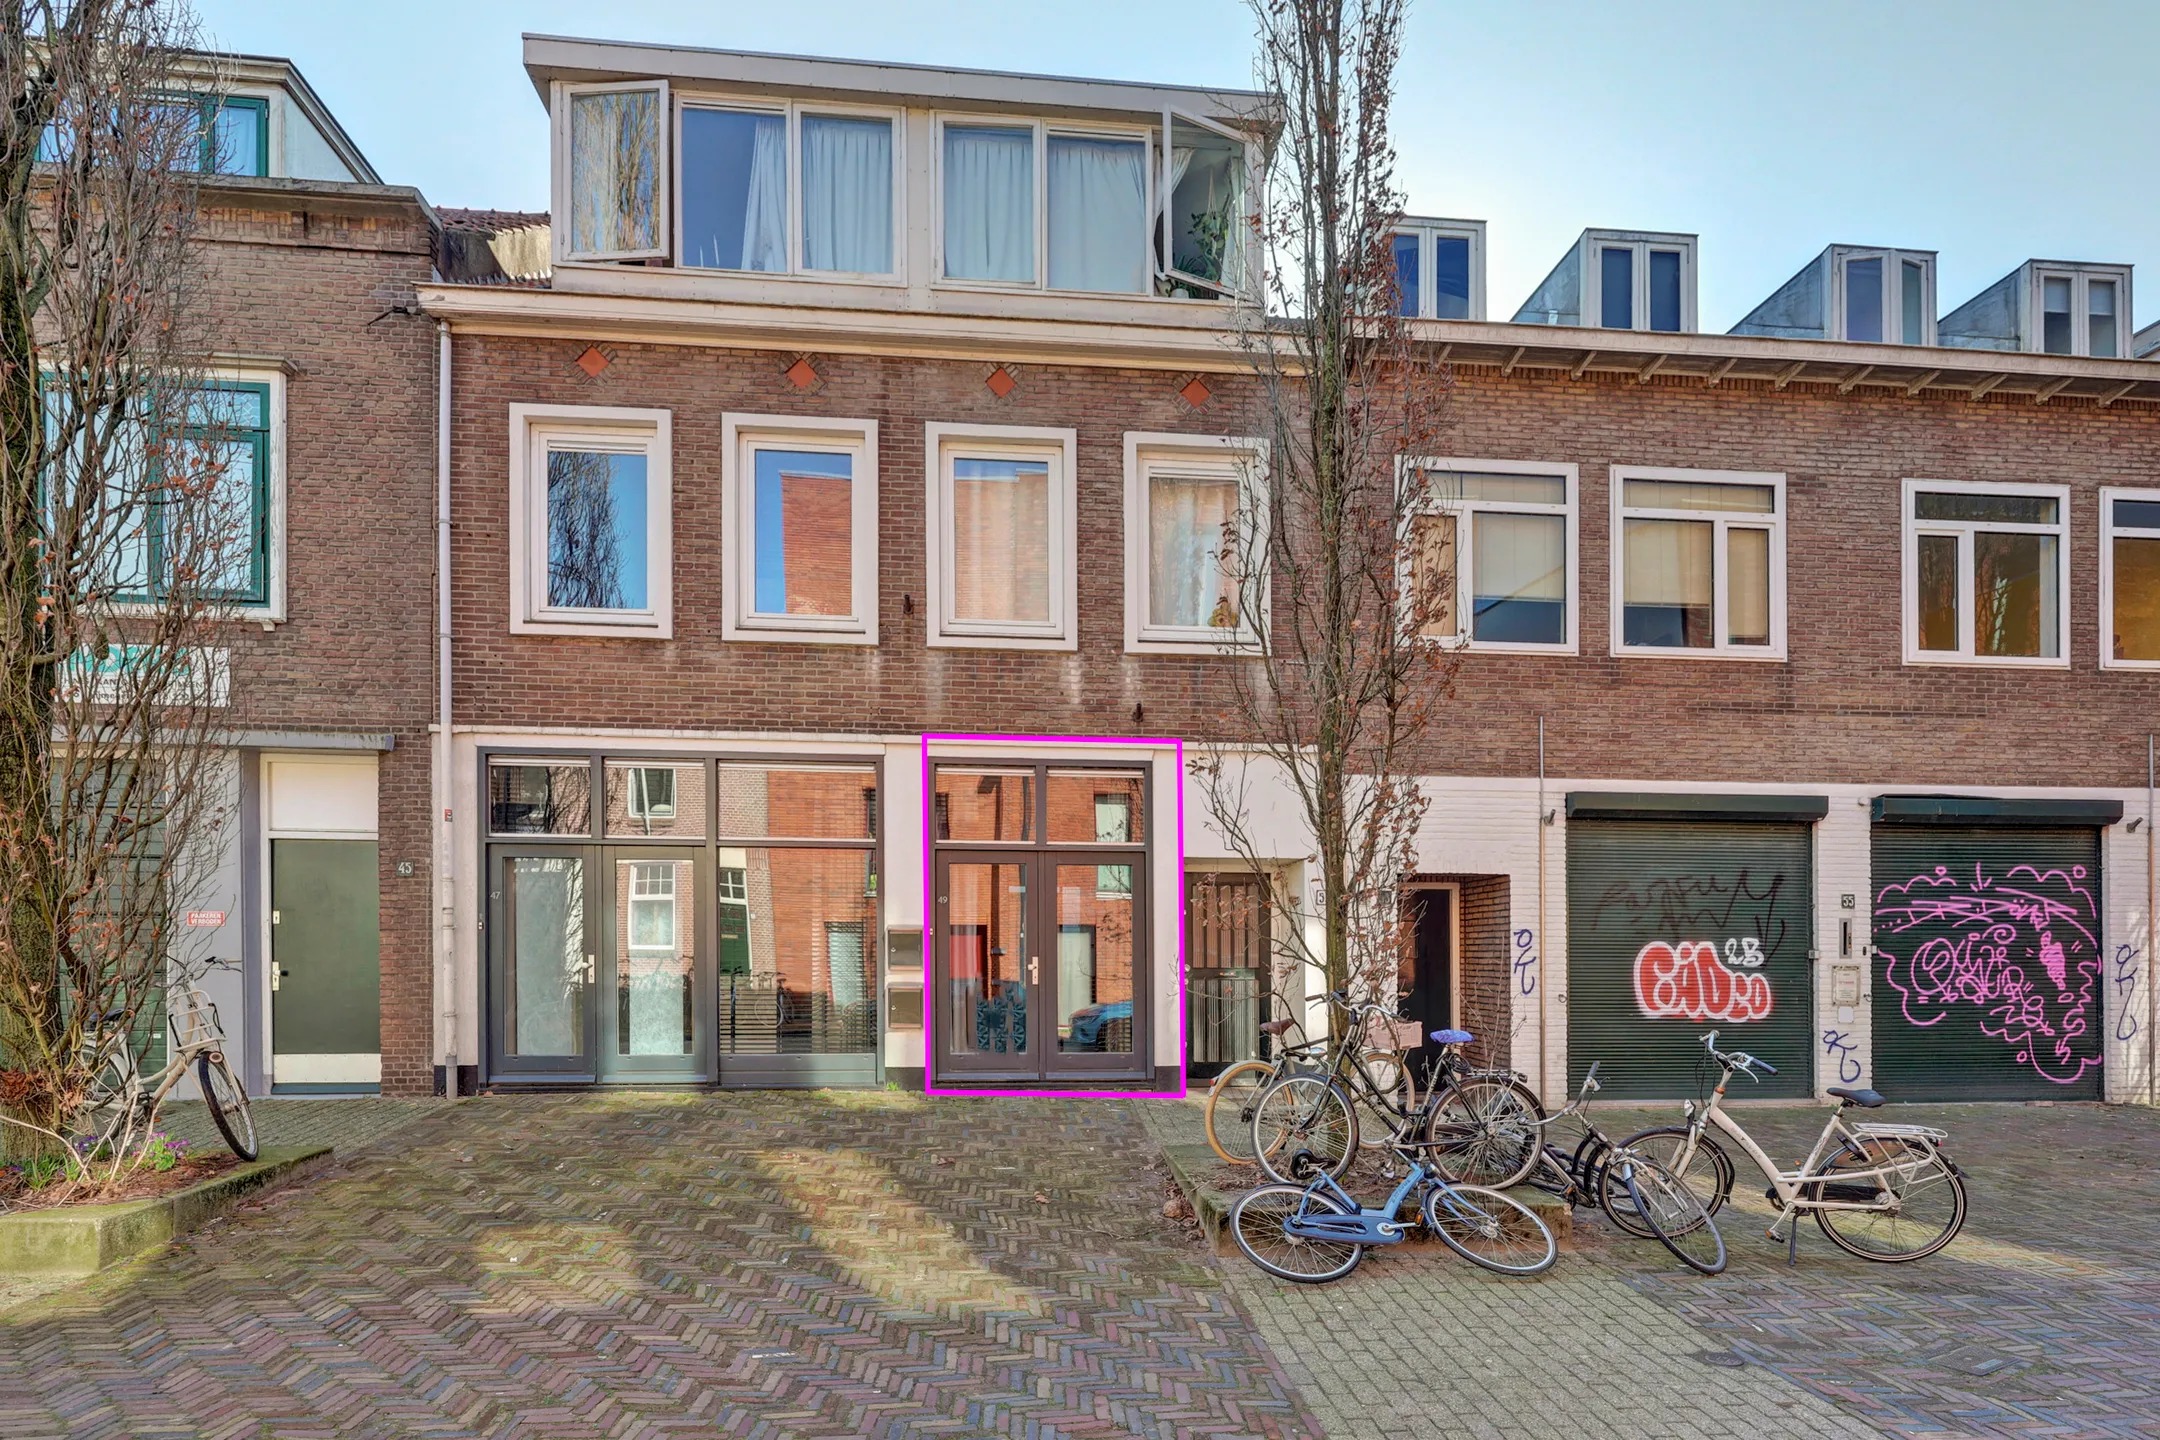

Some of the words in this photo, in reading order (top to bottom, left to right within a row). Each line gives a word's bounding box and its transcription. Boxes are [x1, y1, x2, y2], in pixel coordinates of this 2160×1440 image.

[398, 862, 412, 874] 45
[490, 891, 500, 900] 47
[937, 895, 948, 904] 49
[1843, 896, 1854, 907] 55
